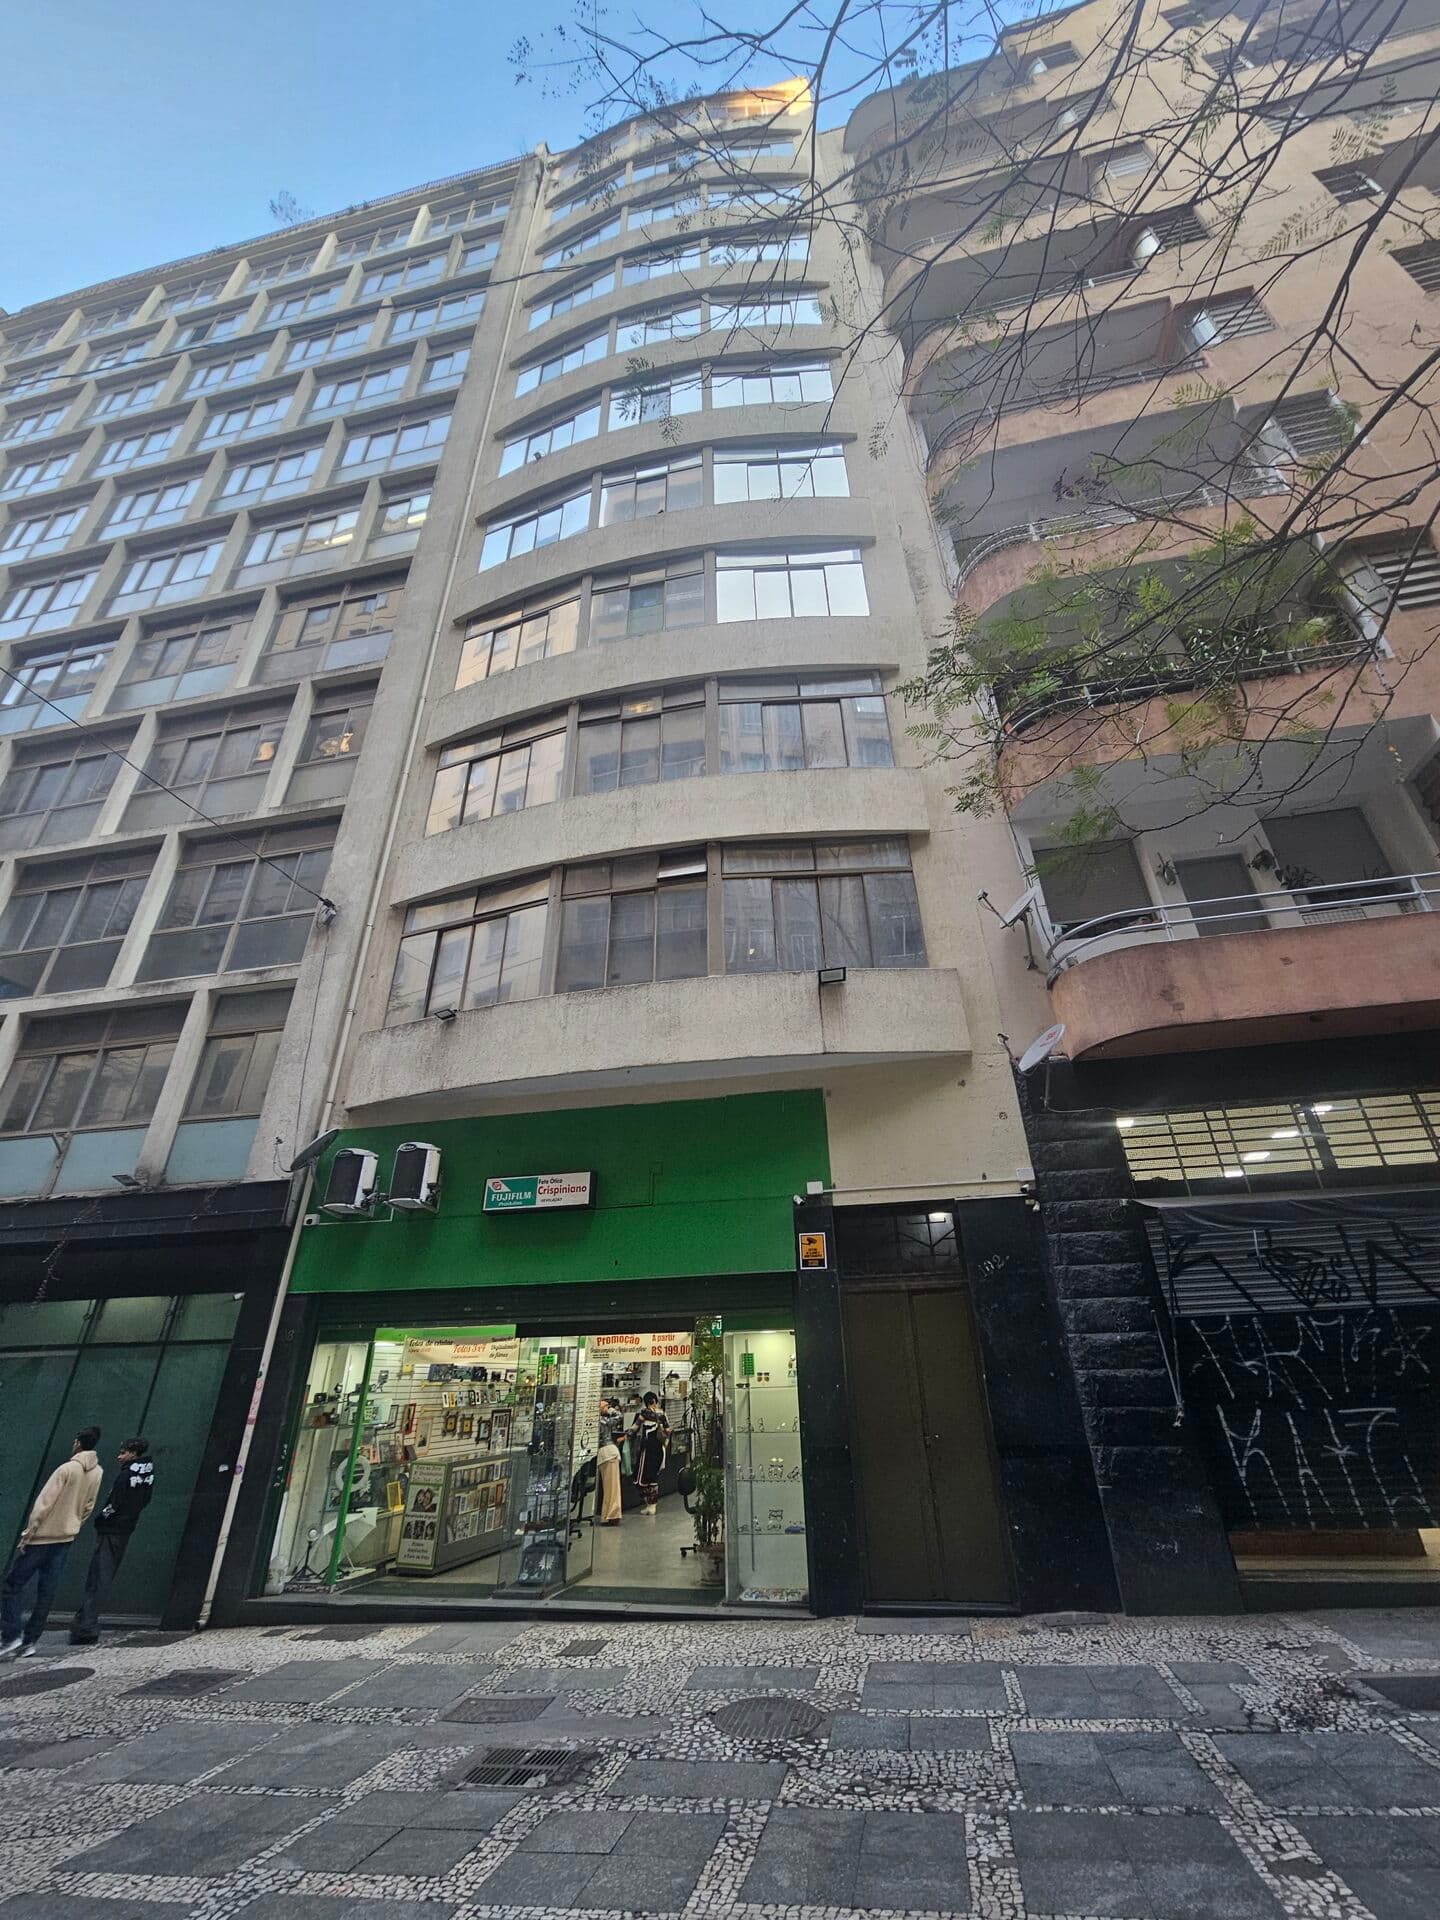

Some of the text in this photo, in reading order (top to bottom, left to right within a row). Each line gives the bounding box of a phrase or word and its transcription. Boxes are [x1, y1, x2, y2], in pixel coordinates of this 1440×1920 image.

[538, 1184, 587, 1196] Crispiniano
[491, 1191, 532, 1202] FUJIFILM
[651, 1345, 662, 1356] R$
